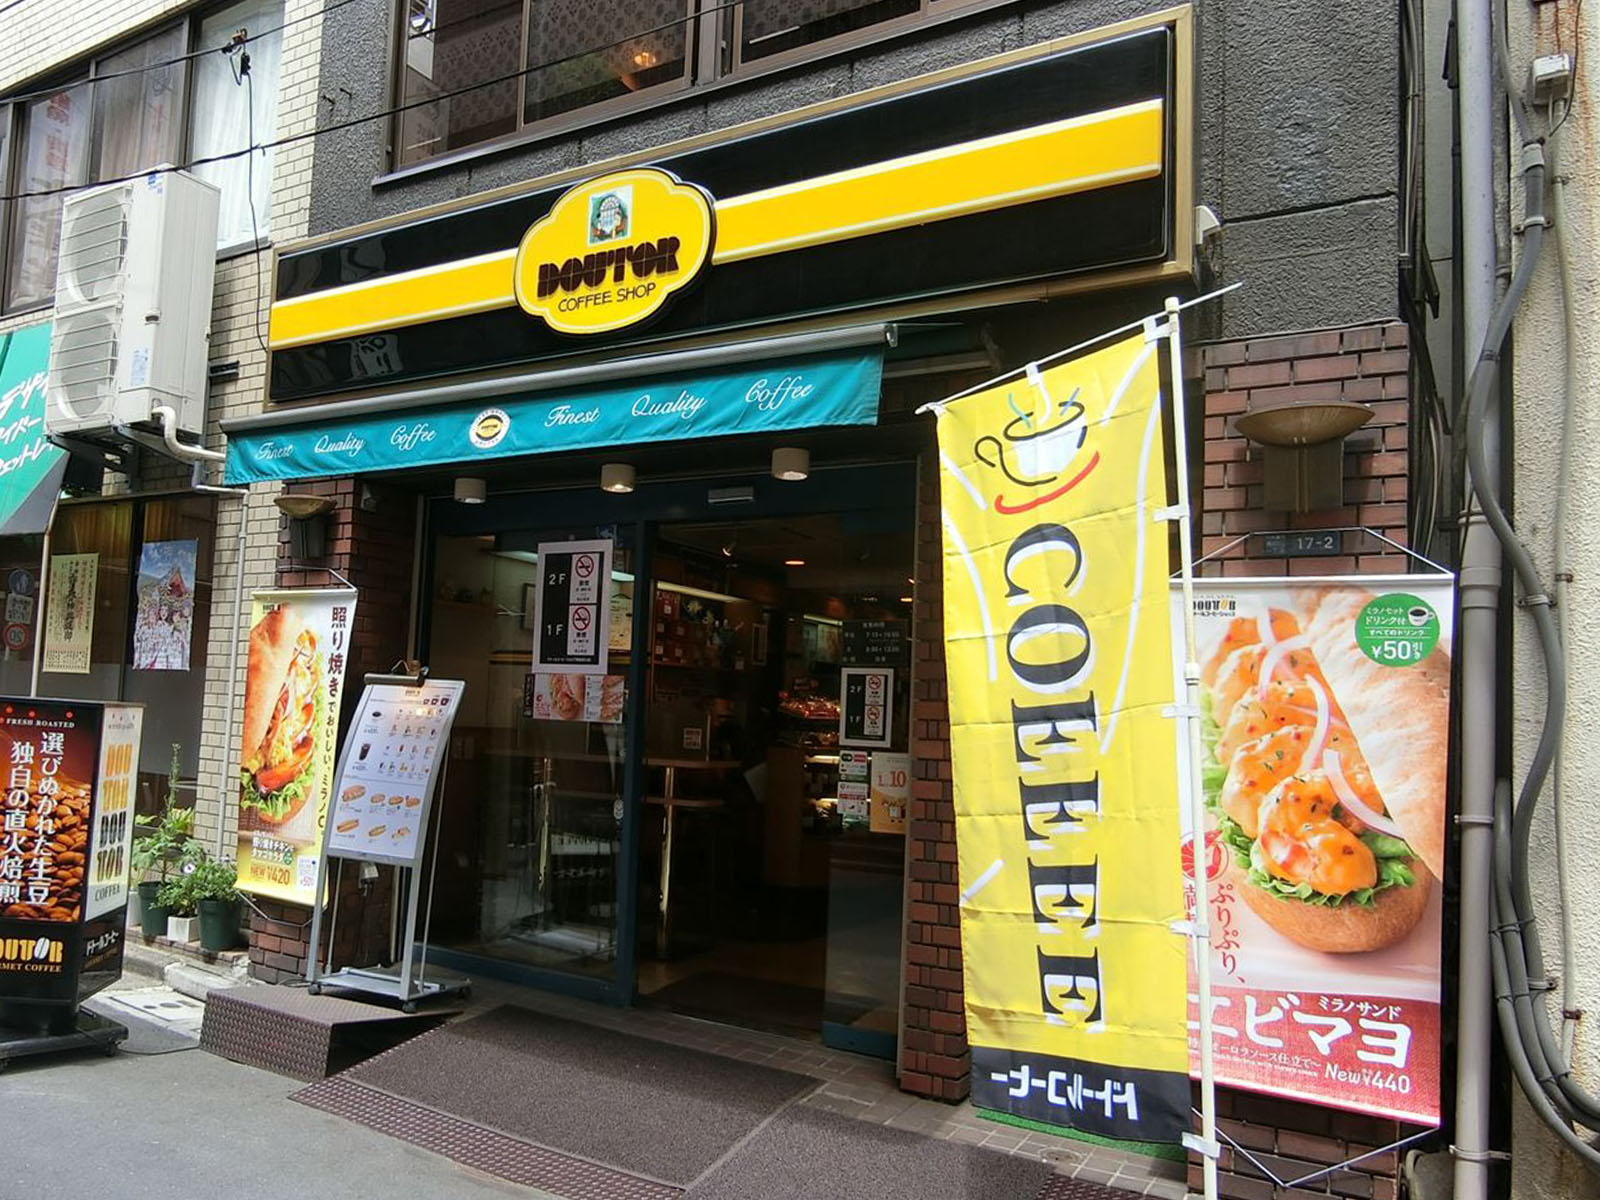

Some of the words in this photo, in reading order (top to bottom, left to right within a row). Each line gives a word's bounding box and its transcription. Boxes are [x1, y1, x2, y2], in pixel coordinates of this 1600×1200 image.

[537, 236, 680, 298] DOUTOR
[558, 290, 613, 312] COFFEE
[616, 282, 656, 302] SHOP
[544, 405, 602, 428] Finest
[630, 390, 707, 419] Quality
[744, 375, 814, 411] Coffee
[255, 441, 296, 461] Finest
[314, 431, 366, 458] Quality
[390, 423, 438, 451] Coffee
[1297, 536, 1333, 550] 17-2
[1366, 607, 1404, 615] ミラノセット
[6, 718, 34, 726] FRESH
[36, 719, 75, 729] ROASTED
[0, 740, 35, 904] 独自の直火焙煎
[26, 731, 65, 905] 選びぬかれた生豆
[99, 810, 126, 849] DOU
[96, 844, 124, 883] TOR
[94, 885, 121, 901] COFFEE
[1210, 882, 1246, 983] ぷりぷり、
[24, 963, 62, 973] COFFEE
[1318, 995, 1402, 1021] ミラノサンド
[1325, 1062, 1360, 1084] New
